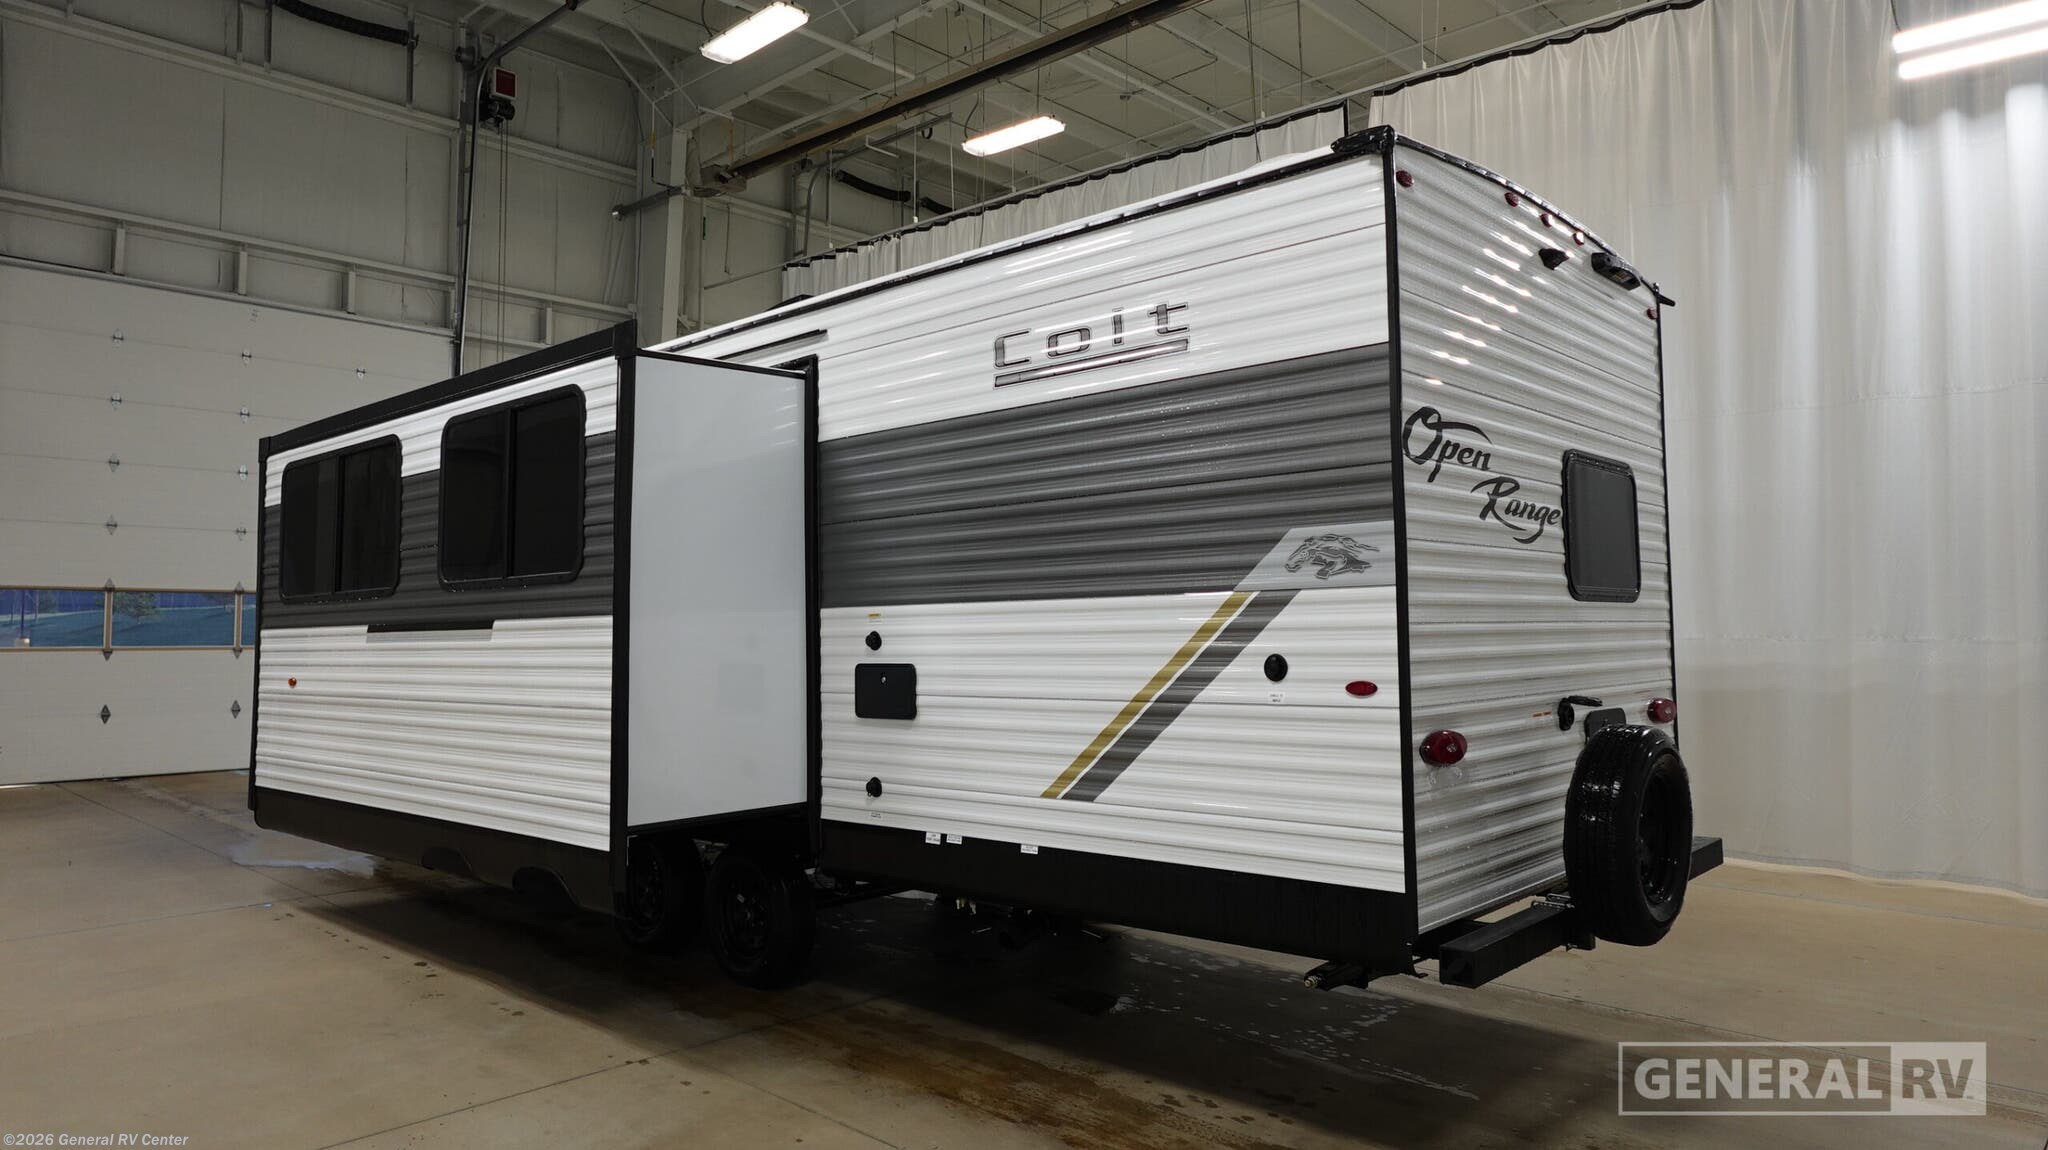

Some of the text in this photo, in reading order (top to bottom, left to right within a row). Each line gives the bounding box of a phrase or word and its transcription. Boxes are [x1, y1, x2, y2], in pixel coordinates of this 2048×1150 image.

[994, 303, 1190, 367] Colt
[1402, 406, 1493, 482] Open
[1470, 476, 1561, 544] Range
